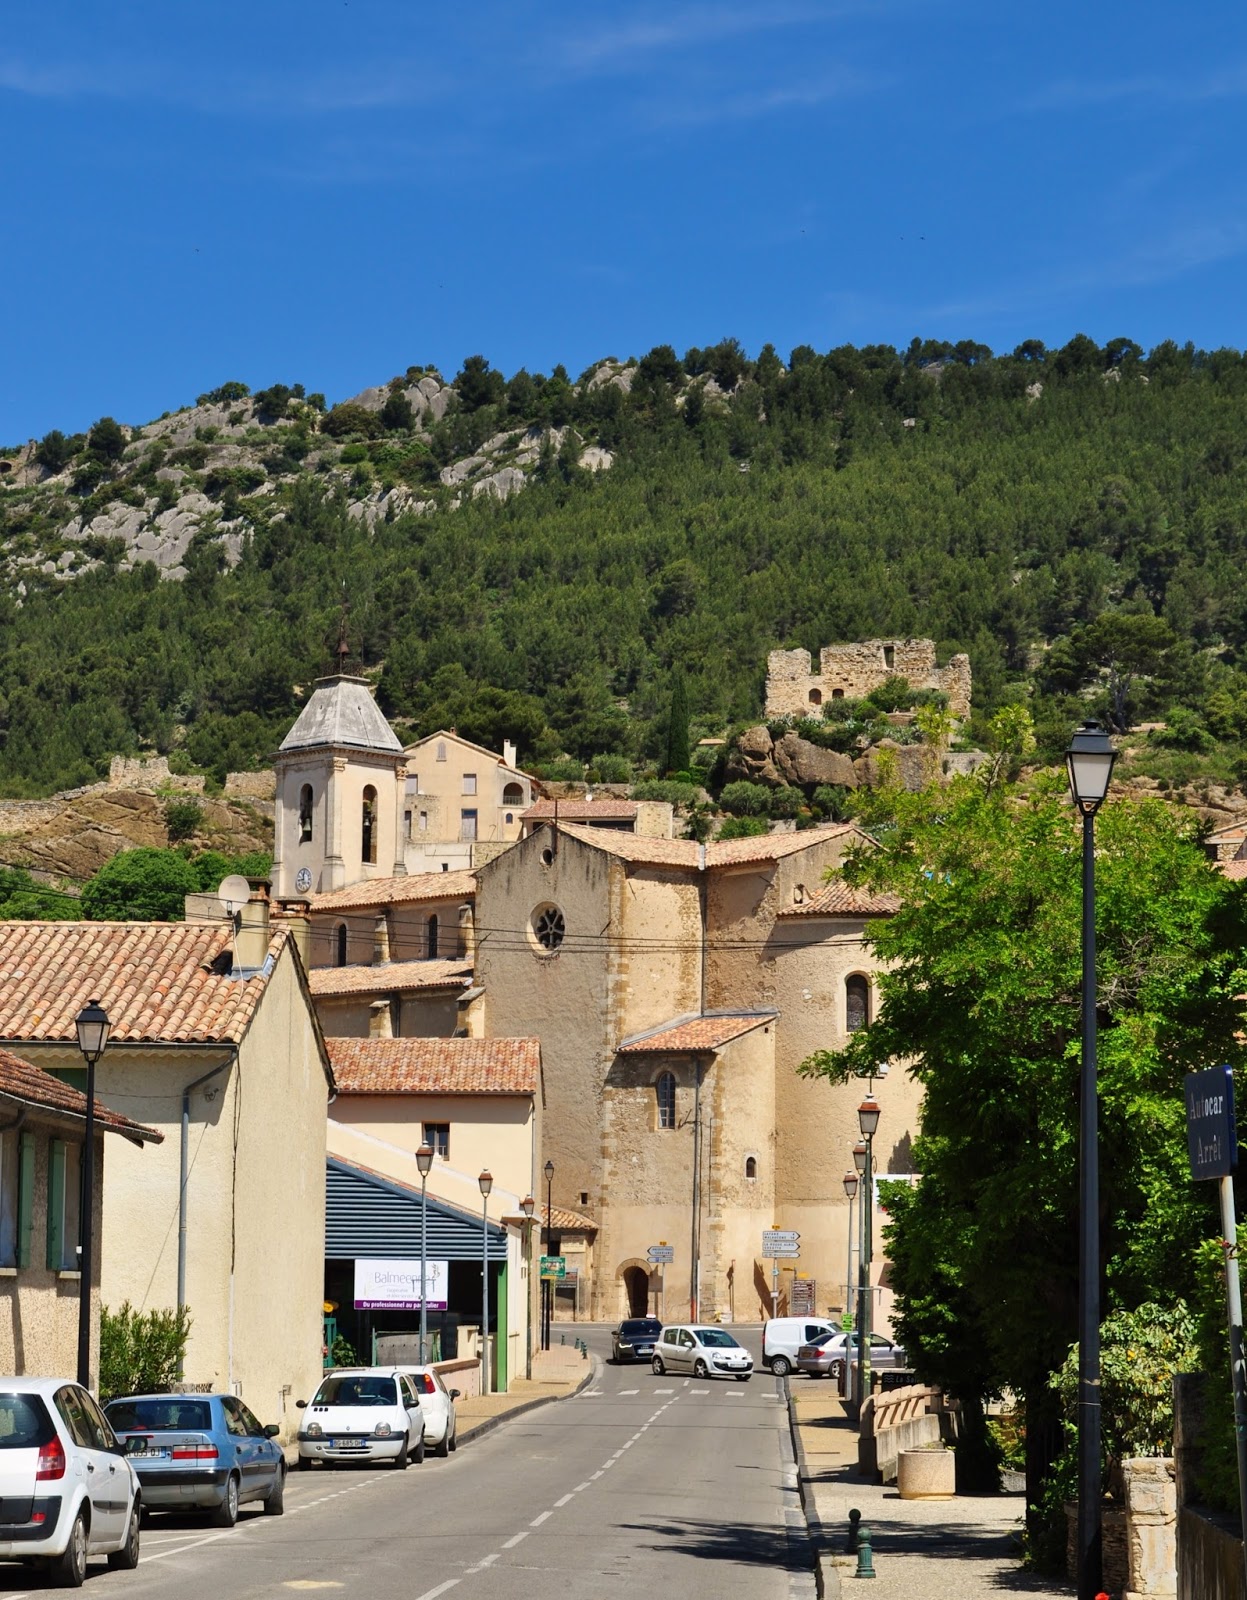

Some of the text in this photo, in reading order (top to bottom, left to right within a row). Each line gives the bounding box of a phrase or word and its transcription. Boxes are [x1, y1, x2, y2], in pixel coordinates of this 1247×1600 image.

[1190, 1092, 1223, 1119] Autocar
[1197, 1134, 1221, 1164] Arrêt
[371, 1301, 405, 1309] professionnel
